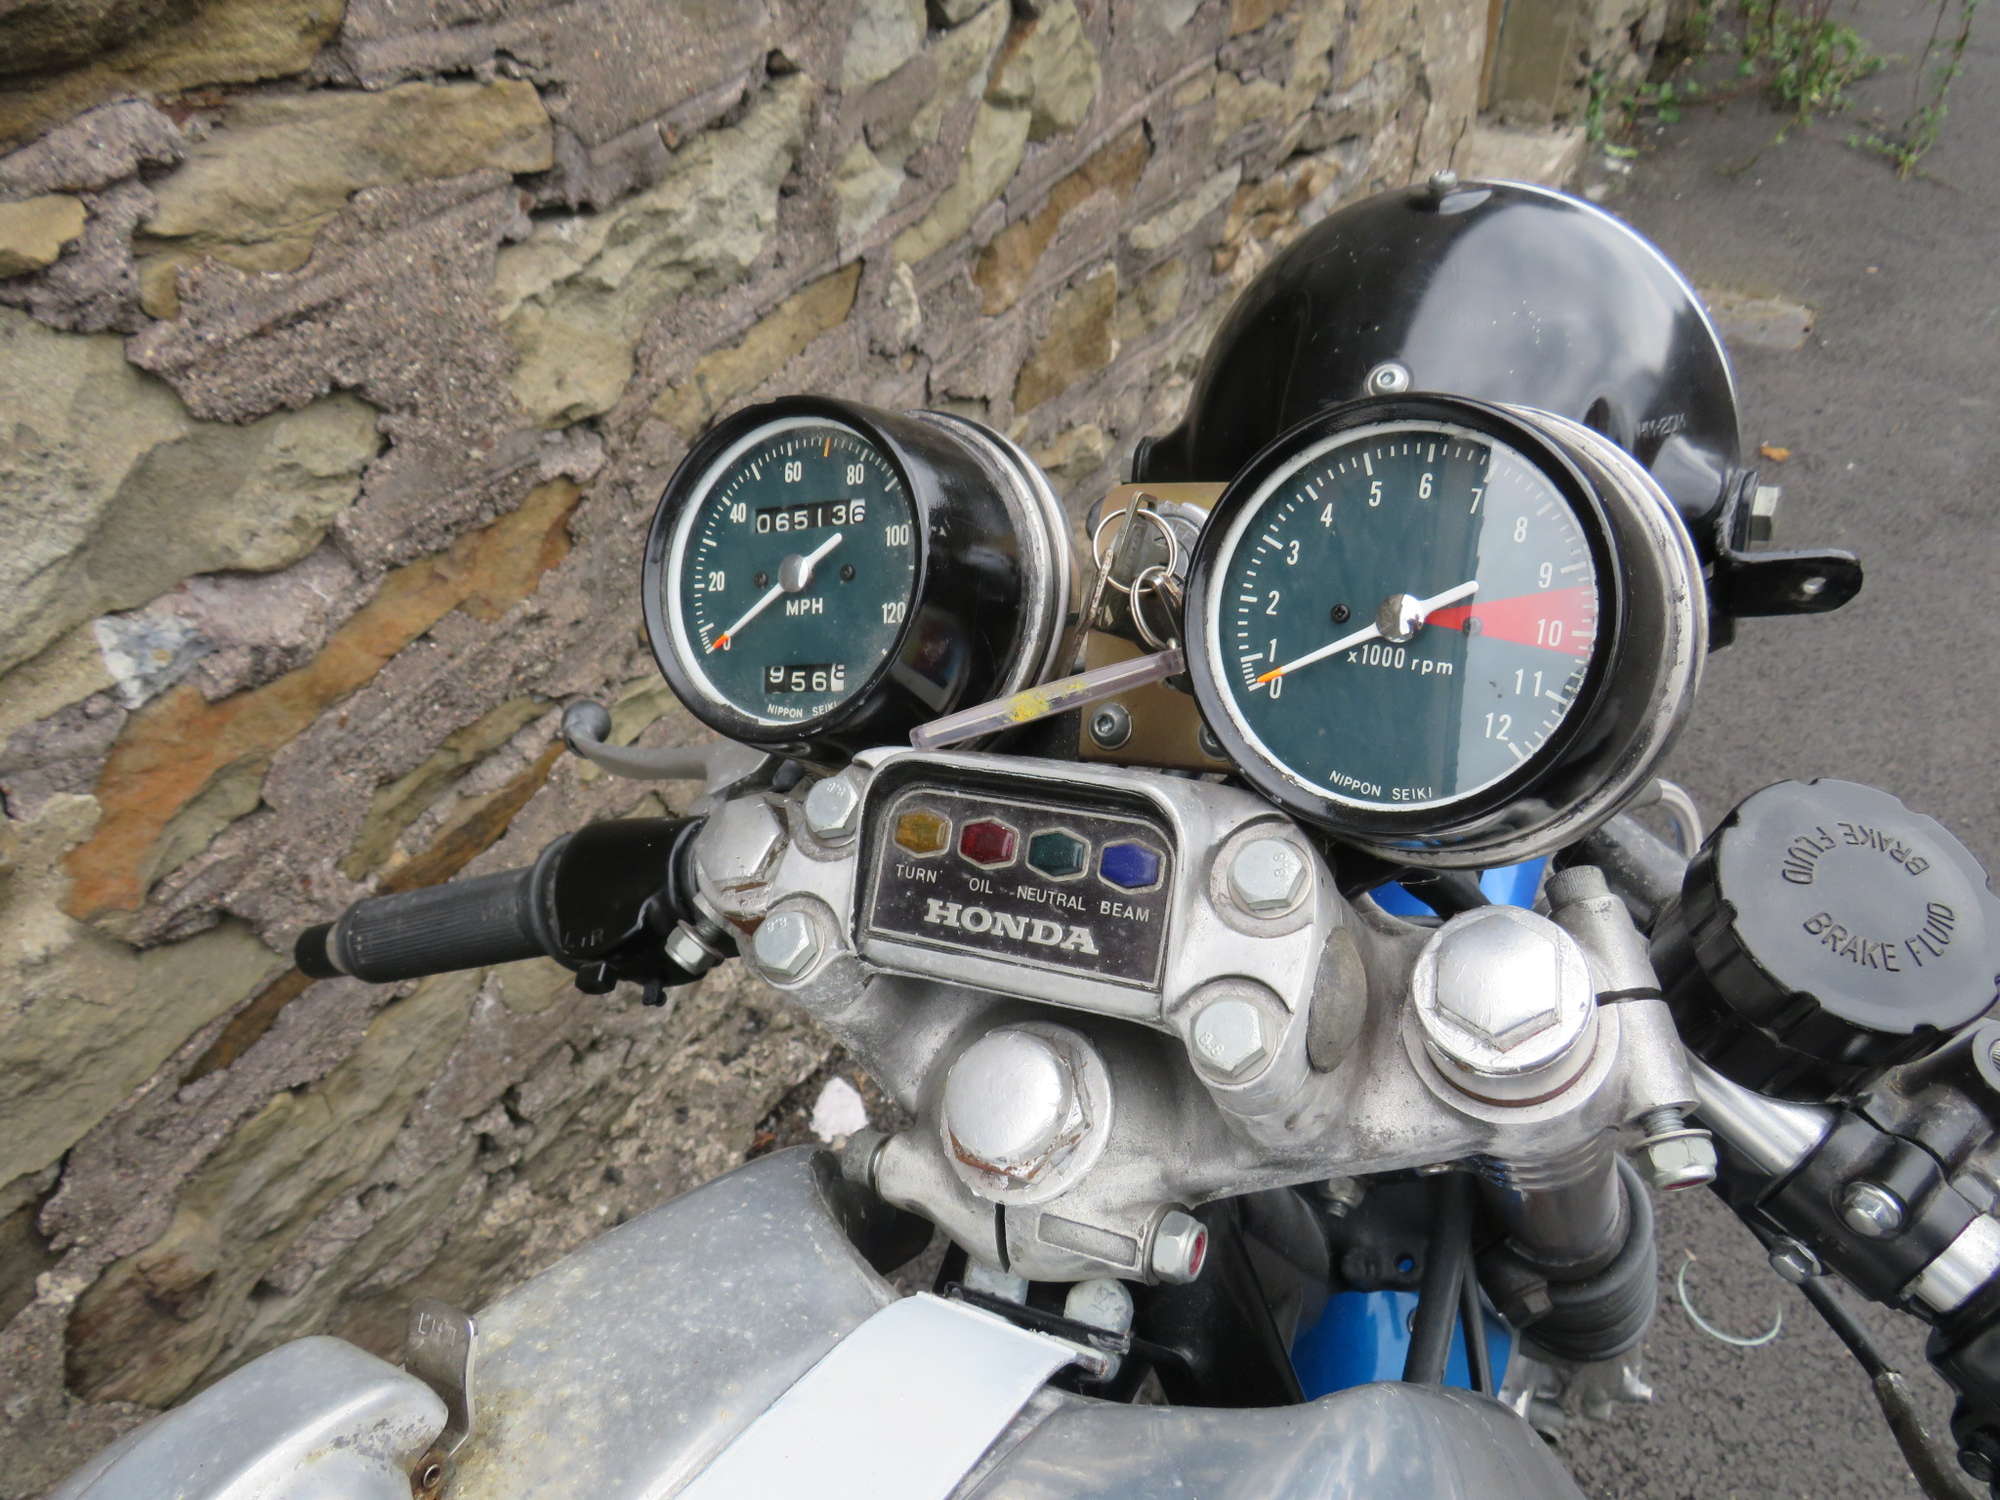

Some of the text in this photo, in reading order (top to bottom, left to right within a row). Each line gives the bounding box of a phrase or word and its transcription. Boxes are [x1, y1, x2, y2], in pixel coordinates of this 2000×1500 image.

[785, 461, 802, 483] 60
[847, 463, 864, 486] 80
[1368, 480, 1383, 507] 5
[1418, 472, 1433, 500] 6
[730, 502, 747, 523] 40
[1469, 487, 1483, 514] 7
[1320, 502, 1334, 528] 4
[885, 524, 909, 546] 100
[1513, 516, 1529, 543] 8
[1286, 540, 1300, 566] 3
[708, 570, 725, 592] 20
[1538, 561, 1553, 588] 9
[785, 597, 824, 616] MPH
[881, 602, 906, 624] 120
[1265, 590, 1281, 616] 2
[1537, 618, 1563, 647] 10
[1268, 638, 1278, 663] 1
[1346, 643, 1453, 676] x1000 rpm
[1269, 675, 1283, 699] 0
[1515, 668, 1543, 697] 11
[767, 700, 839, 719] NIPPON SEIKI
[1485, 712, 1512, 741] 12
[1329, 769, 1432, 801] NIPPON SEIKI
[1781, 822, 1930, 885] BRAKE FLUID
[895, 863, 1151, 923] TURN OIL NEUTRAL BEAM
[923, 897, 1100, 956] HONDA
[1803, 902, 1955, 972] BRAKE FLUID
